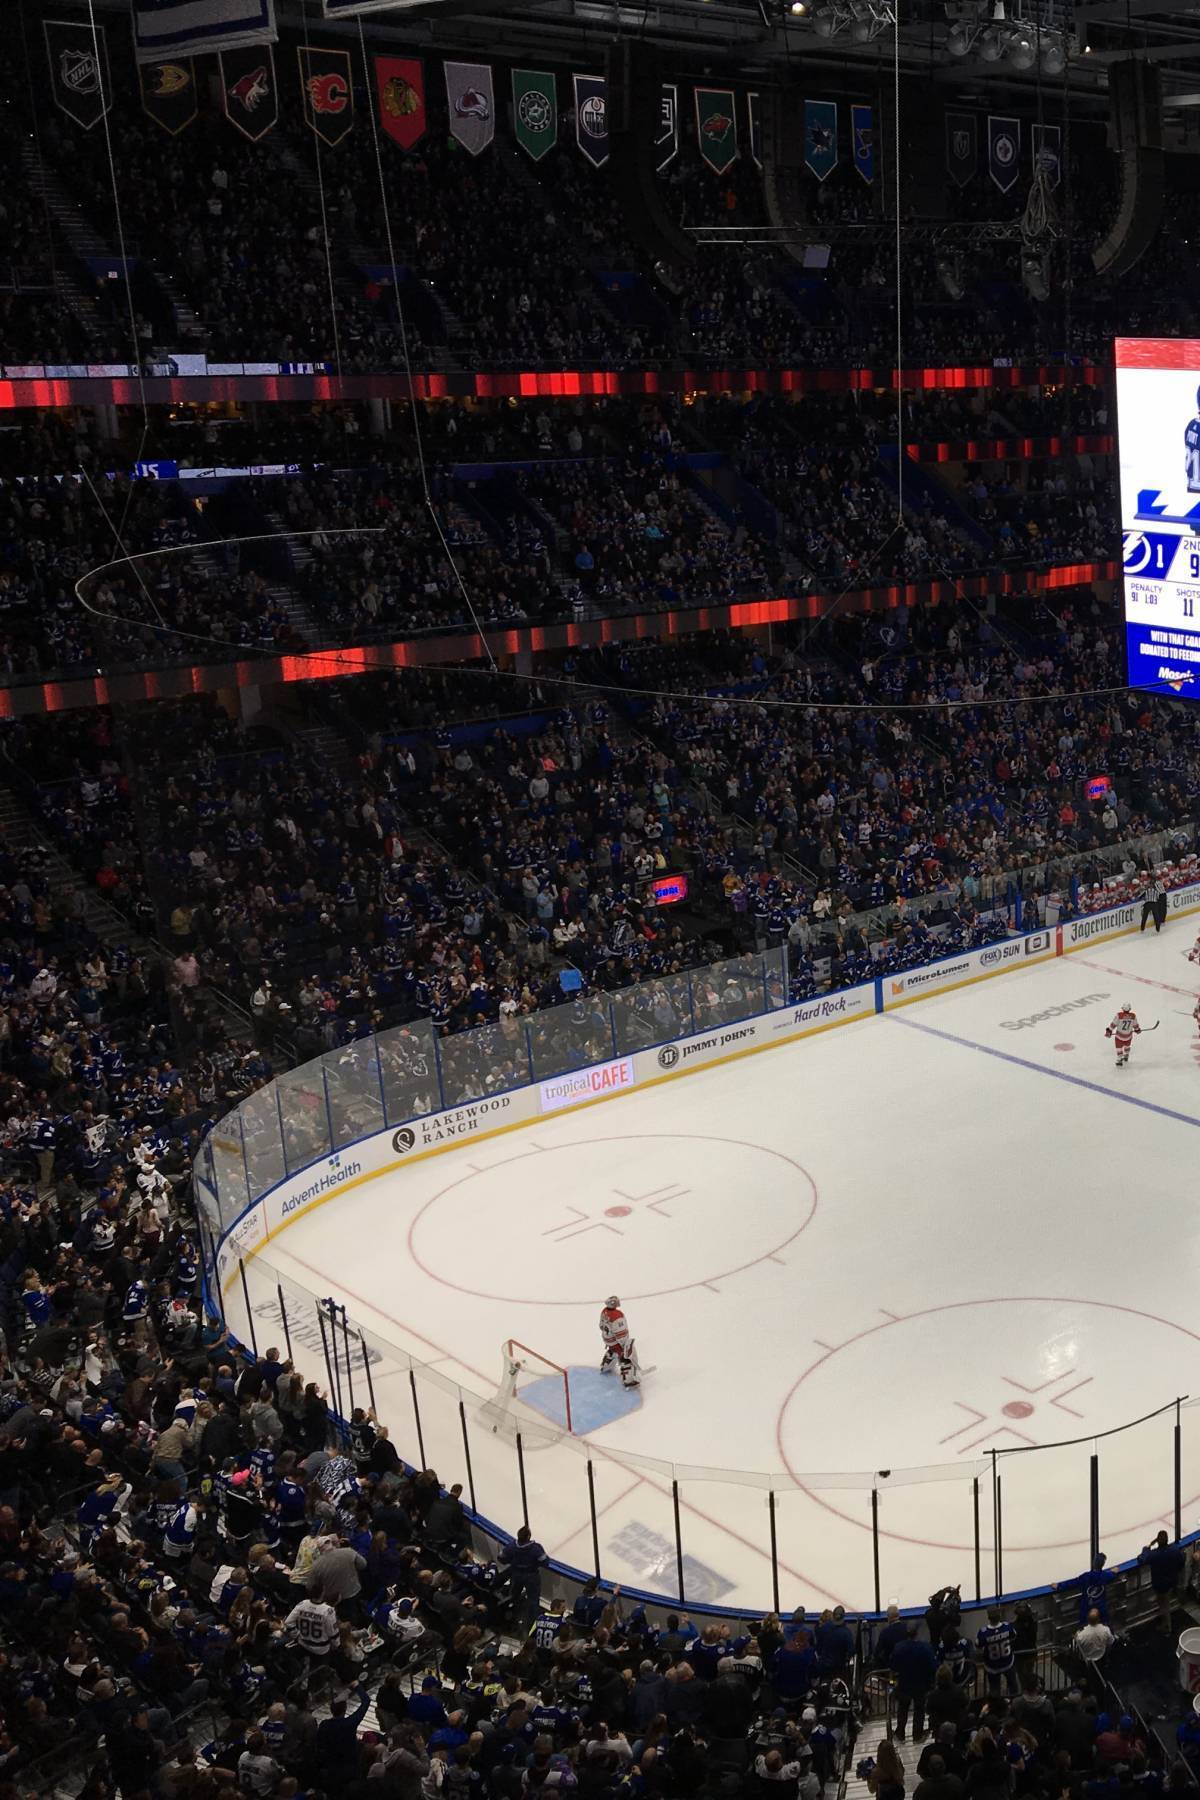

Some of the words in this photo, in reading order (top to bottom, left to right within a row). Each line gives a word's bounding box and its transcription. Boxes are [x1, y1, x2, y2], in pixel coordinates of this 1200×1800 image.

[1156, 544, 1164, 568] 1
[1130, 583, 1162, 593] PENALTY
[1176, 589, 1200, 598] SHOTS
[1131, 592, 1139, 602] 91
[1144, 594, 1158, 605] 1:03
[1183, 598, 1193, 617] 11
[1151, 630, 1168, 643] WITH
[1169, 632, 1184, 645] THAT
[1140, 643, 1169, 657] DONATED
[1169, 648, 1178, 659] TO
[1158, 667, 1194, 683] Mosaic
[984, 952, 998, 962] FOX
[1003, 944, 1021, 959] SUN
[907, 962, 969, 985] MicroLumen
[794, 1004, 821, 1024] Hard
[822, 997, 847, 1016] Rock
[999, 991, 1105, 1031] Spectrum
[1122, 1020, 1131, 1031] 27
[682, 1039, 718, 1058] JIMMY
[720, 1027, 756, 1046] JOHN'S
[546, 1074, 591, 1099] tropical
[591, 1063, 628, 1091] CAFE
[421, 1096, 511, 1132] LAKEWOOD
[424, 1119, 478, 1144] RANCH
